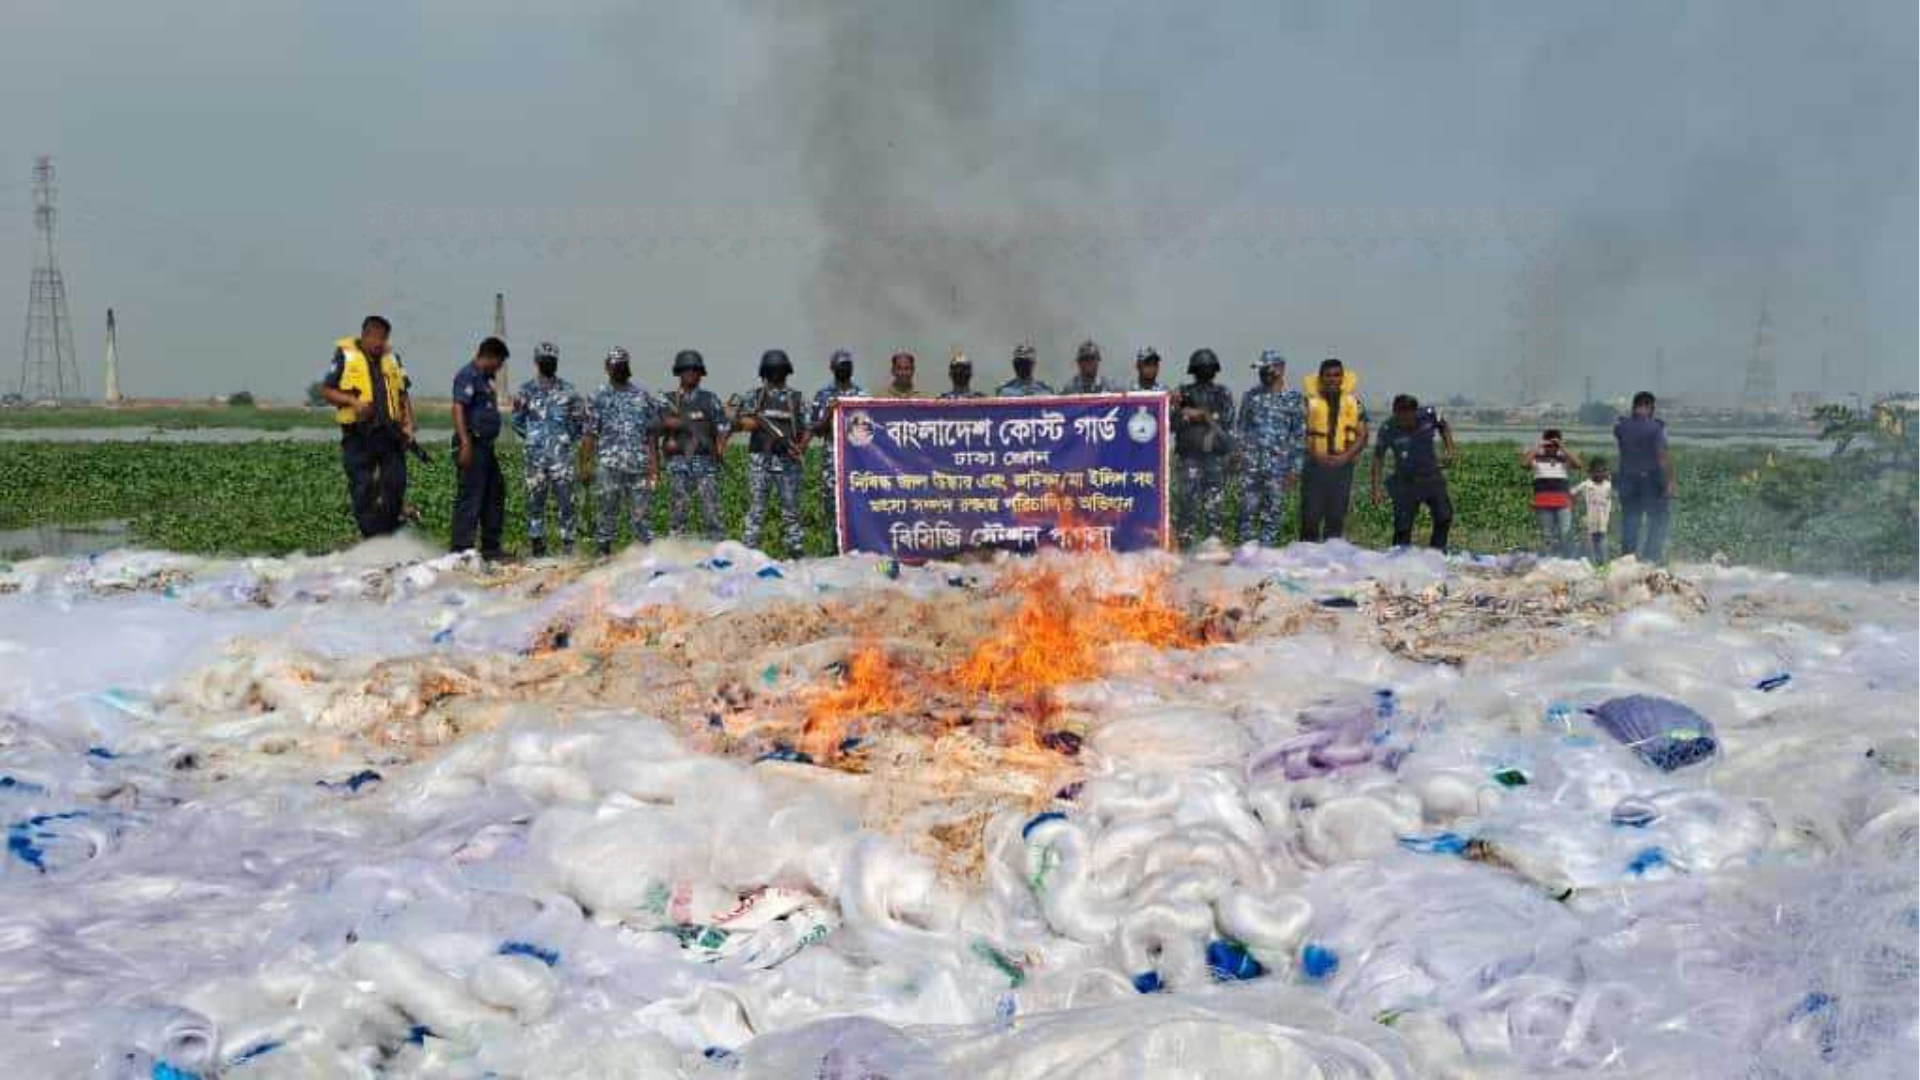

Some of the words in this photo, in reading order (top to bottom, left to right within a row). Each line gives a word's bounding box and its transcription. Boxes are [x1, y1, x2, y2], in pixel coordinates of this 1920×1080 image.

[885, 418, 993, 450] বাংলাদেশ
[1000, 410, 1064, 445] কোস্ট
[1074, 406, 1119, 443] গার্ড
[953, 452, 995, 467] ঢাকা
[1003, 450, 1050, 466] জোন
[976, 473, 1007, 491] এবং
[1088, 466, 1127, 488] ইলিশ
[1132, 471, 1154, 488] সহ
[889, 520, 962, 550] বিসিজি
